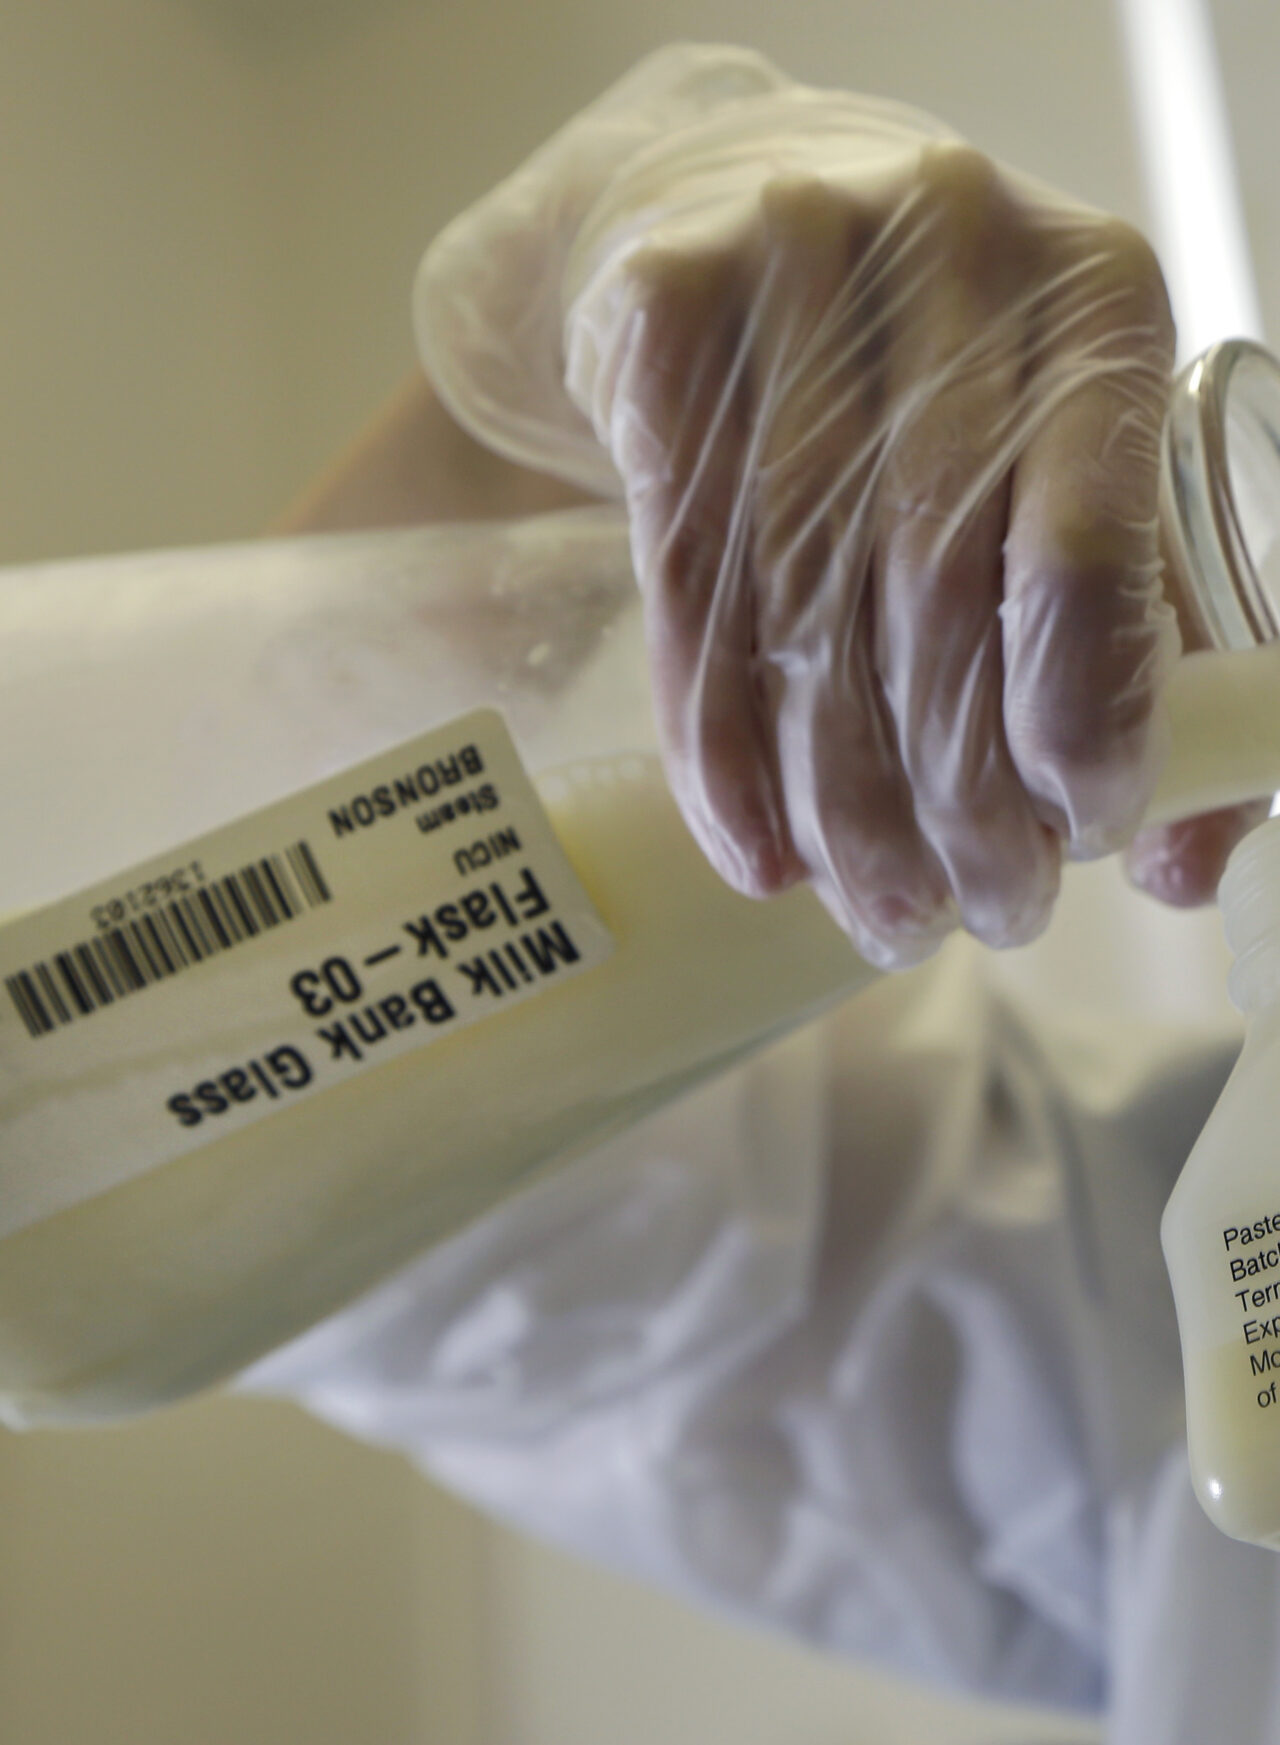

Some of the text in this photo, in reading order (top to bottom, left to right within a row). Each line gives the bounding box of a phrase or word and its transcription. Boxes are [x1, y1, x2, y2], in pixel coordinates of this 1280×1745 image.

[328, 744, 485, 837] BRONSON
[416, 783, 500, 834] Steam
[453, 827, 521, 876] NICU
[166, 920, 582, 1127] Milk Bank Glass
[1257, 1384, 1277, 1408] of
